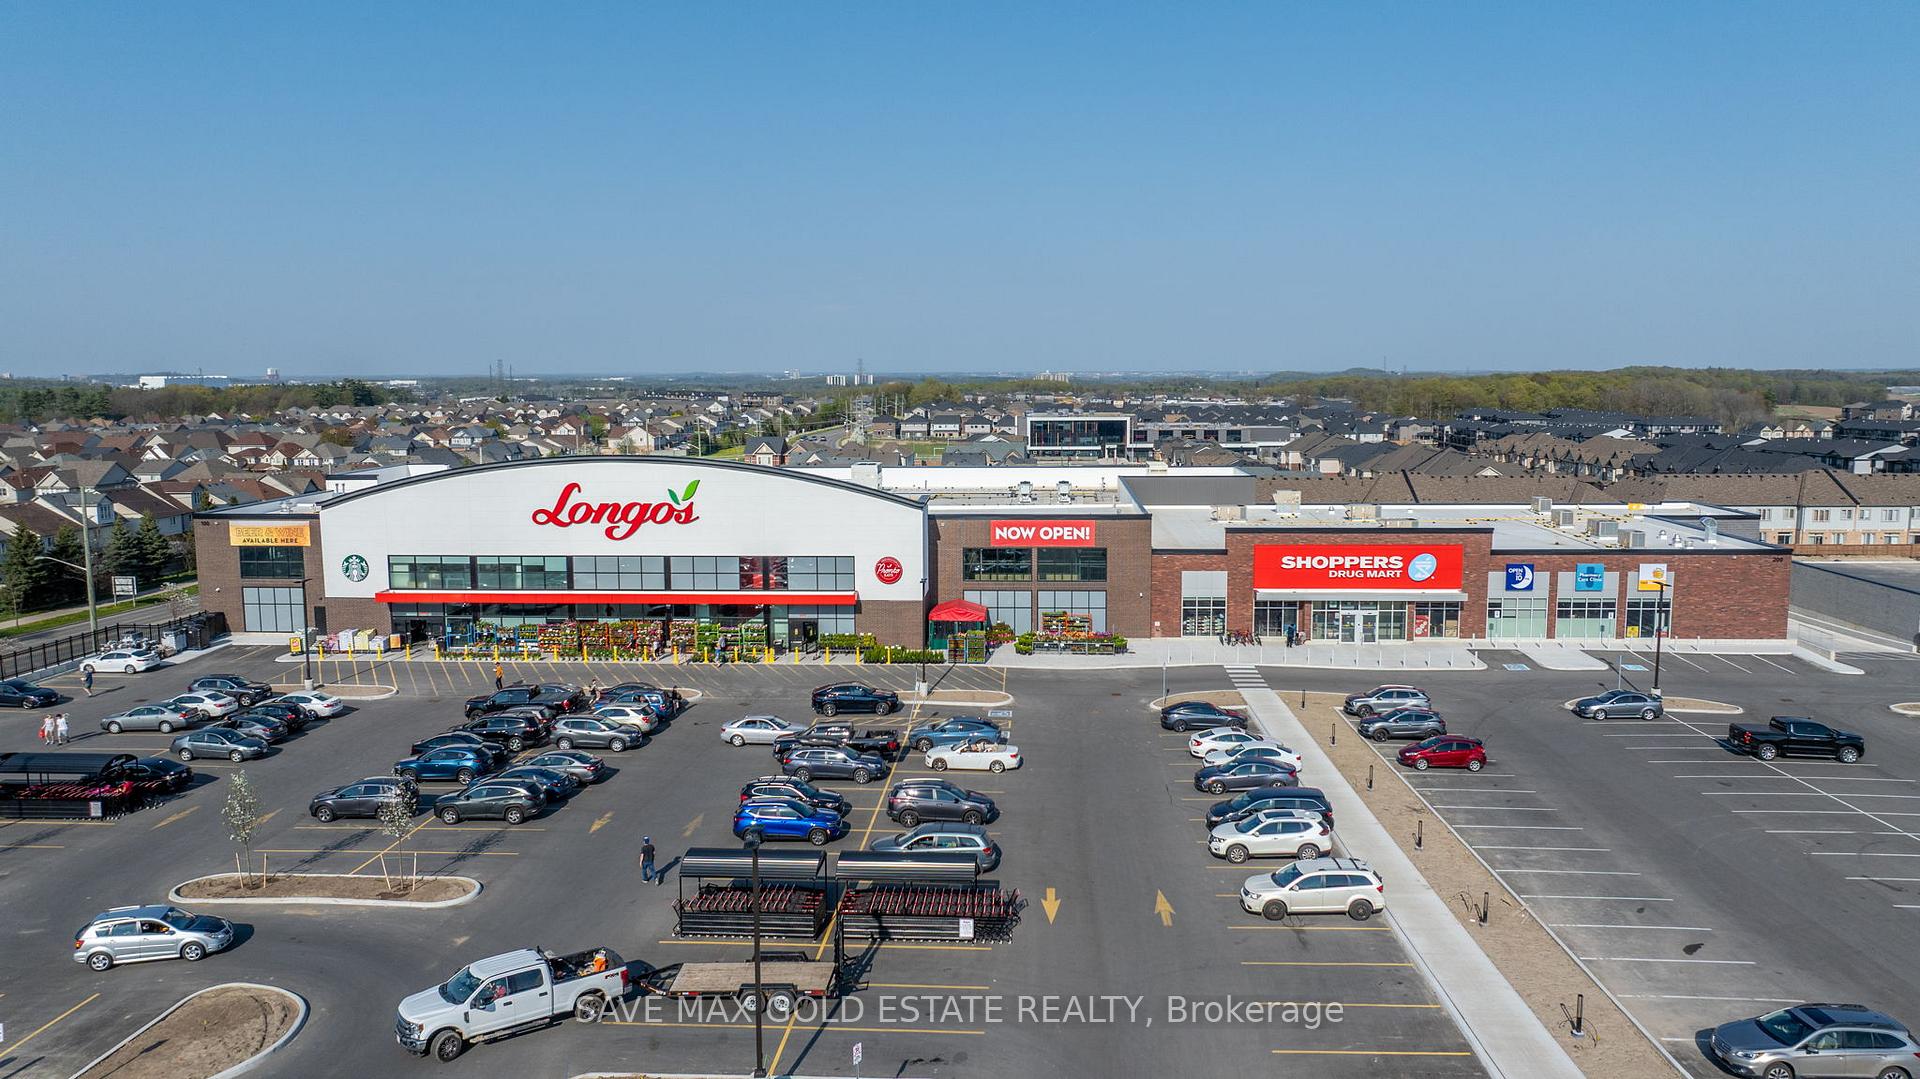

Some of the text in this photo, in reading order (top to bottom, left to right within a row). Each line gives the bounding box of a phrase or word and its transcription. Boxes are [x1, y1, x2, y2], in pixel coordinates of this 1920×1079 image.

[236, 527, 263, 537] BEER
[275, 527, 304, 537] WINE
[995, 526, 1090, 540] NOW OPEN!
[1280, 556, 1404, 569] SHOPPERS
[1328, 569, 1403, 578] DRUG MART
